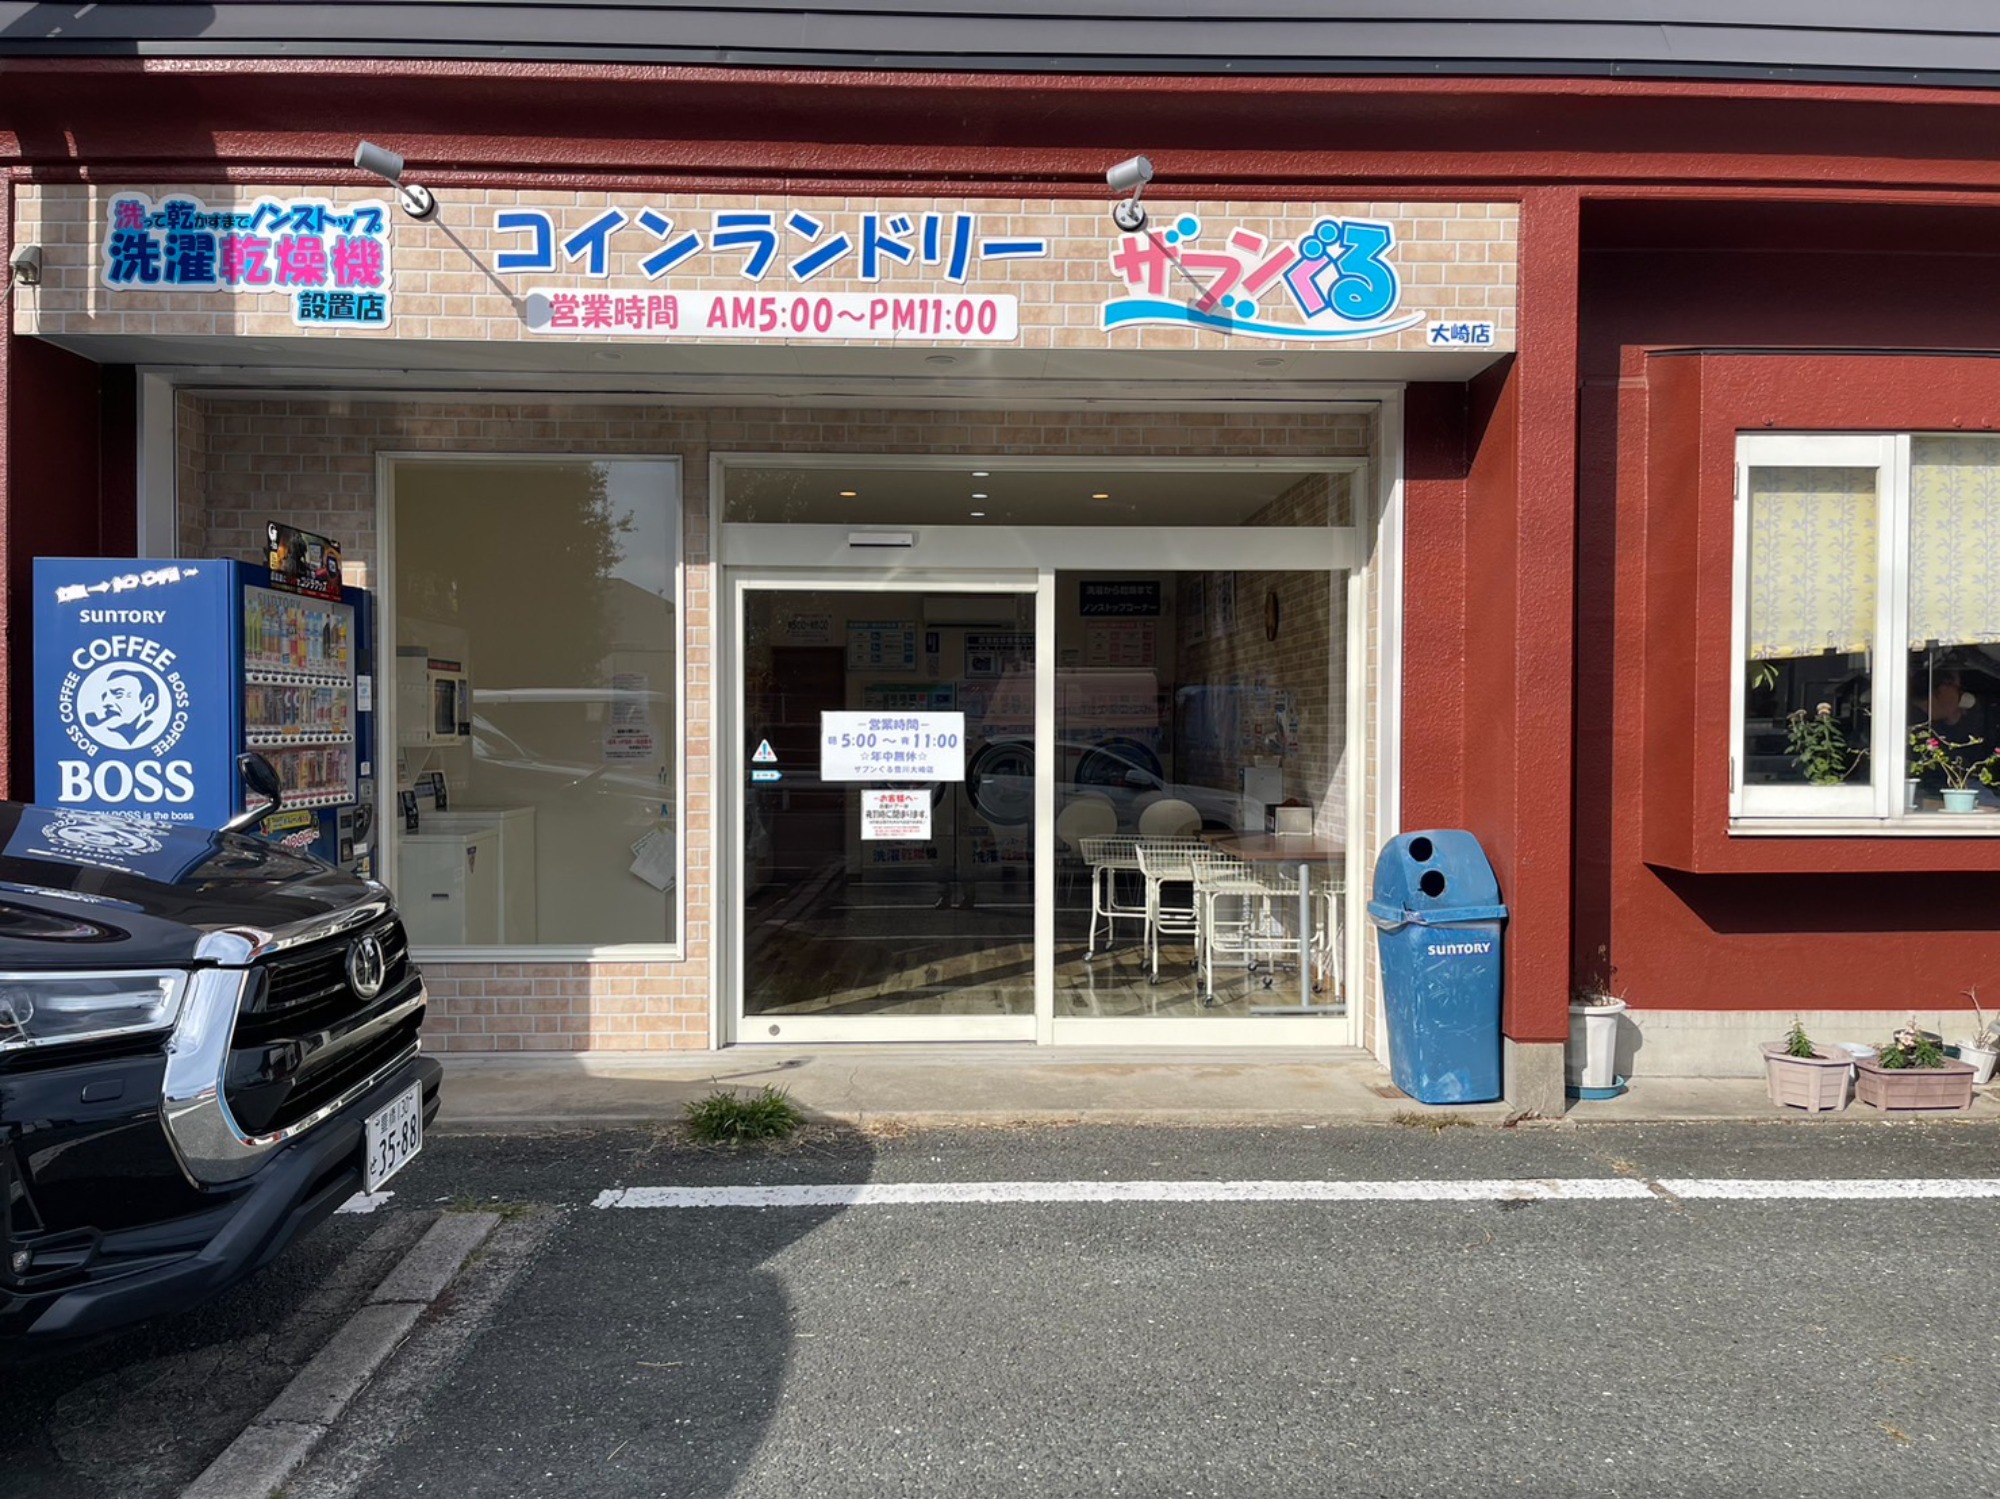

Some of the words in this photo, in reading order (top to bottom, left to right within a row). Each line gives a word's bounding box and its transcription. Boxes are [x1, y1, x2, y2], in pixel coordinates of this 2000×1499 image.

[109, 232, 384, 286] 洗濯乾燥機
[497, 208, 1044, 278] コインランドリー
[300, 292, 384, 321] 設置店
[548, 293, 679, 331] 営業時間
[1430, 323, 1492, 344] 大崎店
[79, 609, 167, 625] SUNTORY
[72, 634, 177, 673] COFFEE
[58, 671, 81, 723] COFFEE
[167, 671, 189, 708] BOSS
[65, 724, 99, 757] BOSS
[150, 711, 189, 757] COFFEE
[914, 733, 958, 748] 11:00
[57, 759, 195, 803] BOSS
[154, 810, 169, 820] the
[171, 810, 194, 821] boss
[1427, 942, 1491, 956] SUNTORY
[378, 1112, 417, 1177] 35-88
